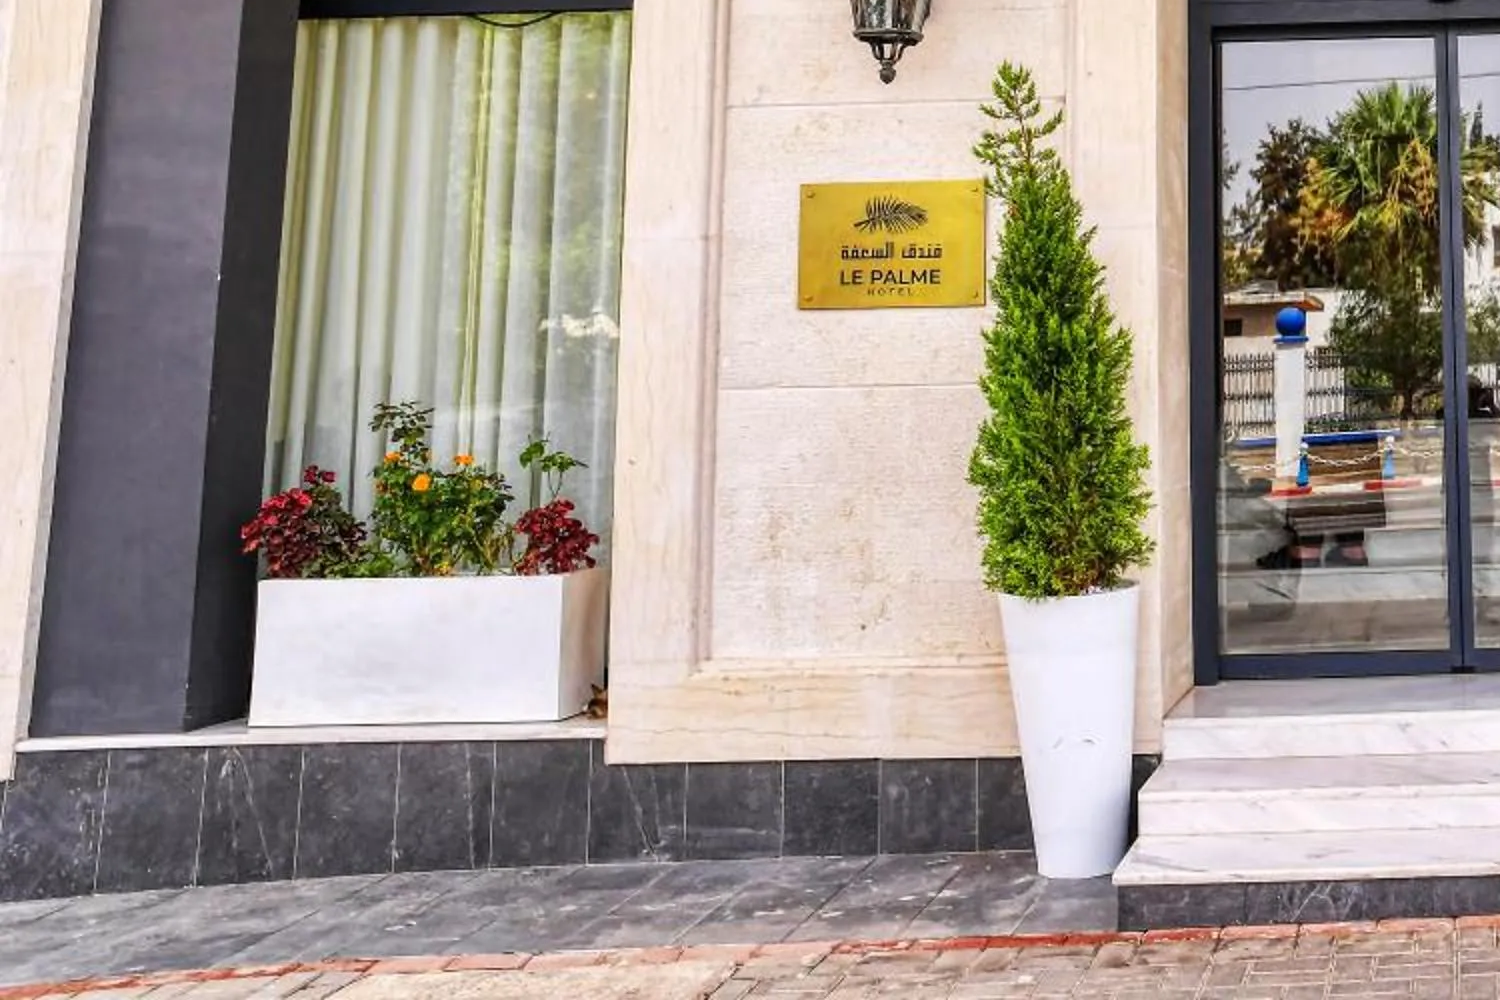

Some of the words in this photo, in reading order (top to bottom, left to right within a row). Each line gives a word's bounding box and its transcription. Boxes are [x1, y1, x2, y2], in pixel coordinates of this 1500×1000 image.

[841, 241, 895, 260] السعفة
[901, 243, 943, 259] فندق
[839, 269, 863, 285] LE
[870, 268, 941, 285] PALME
[866, 286, 913, 297] HOTEL
